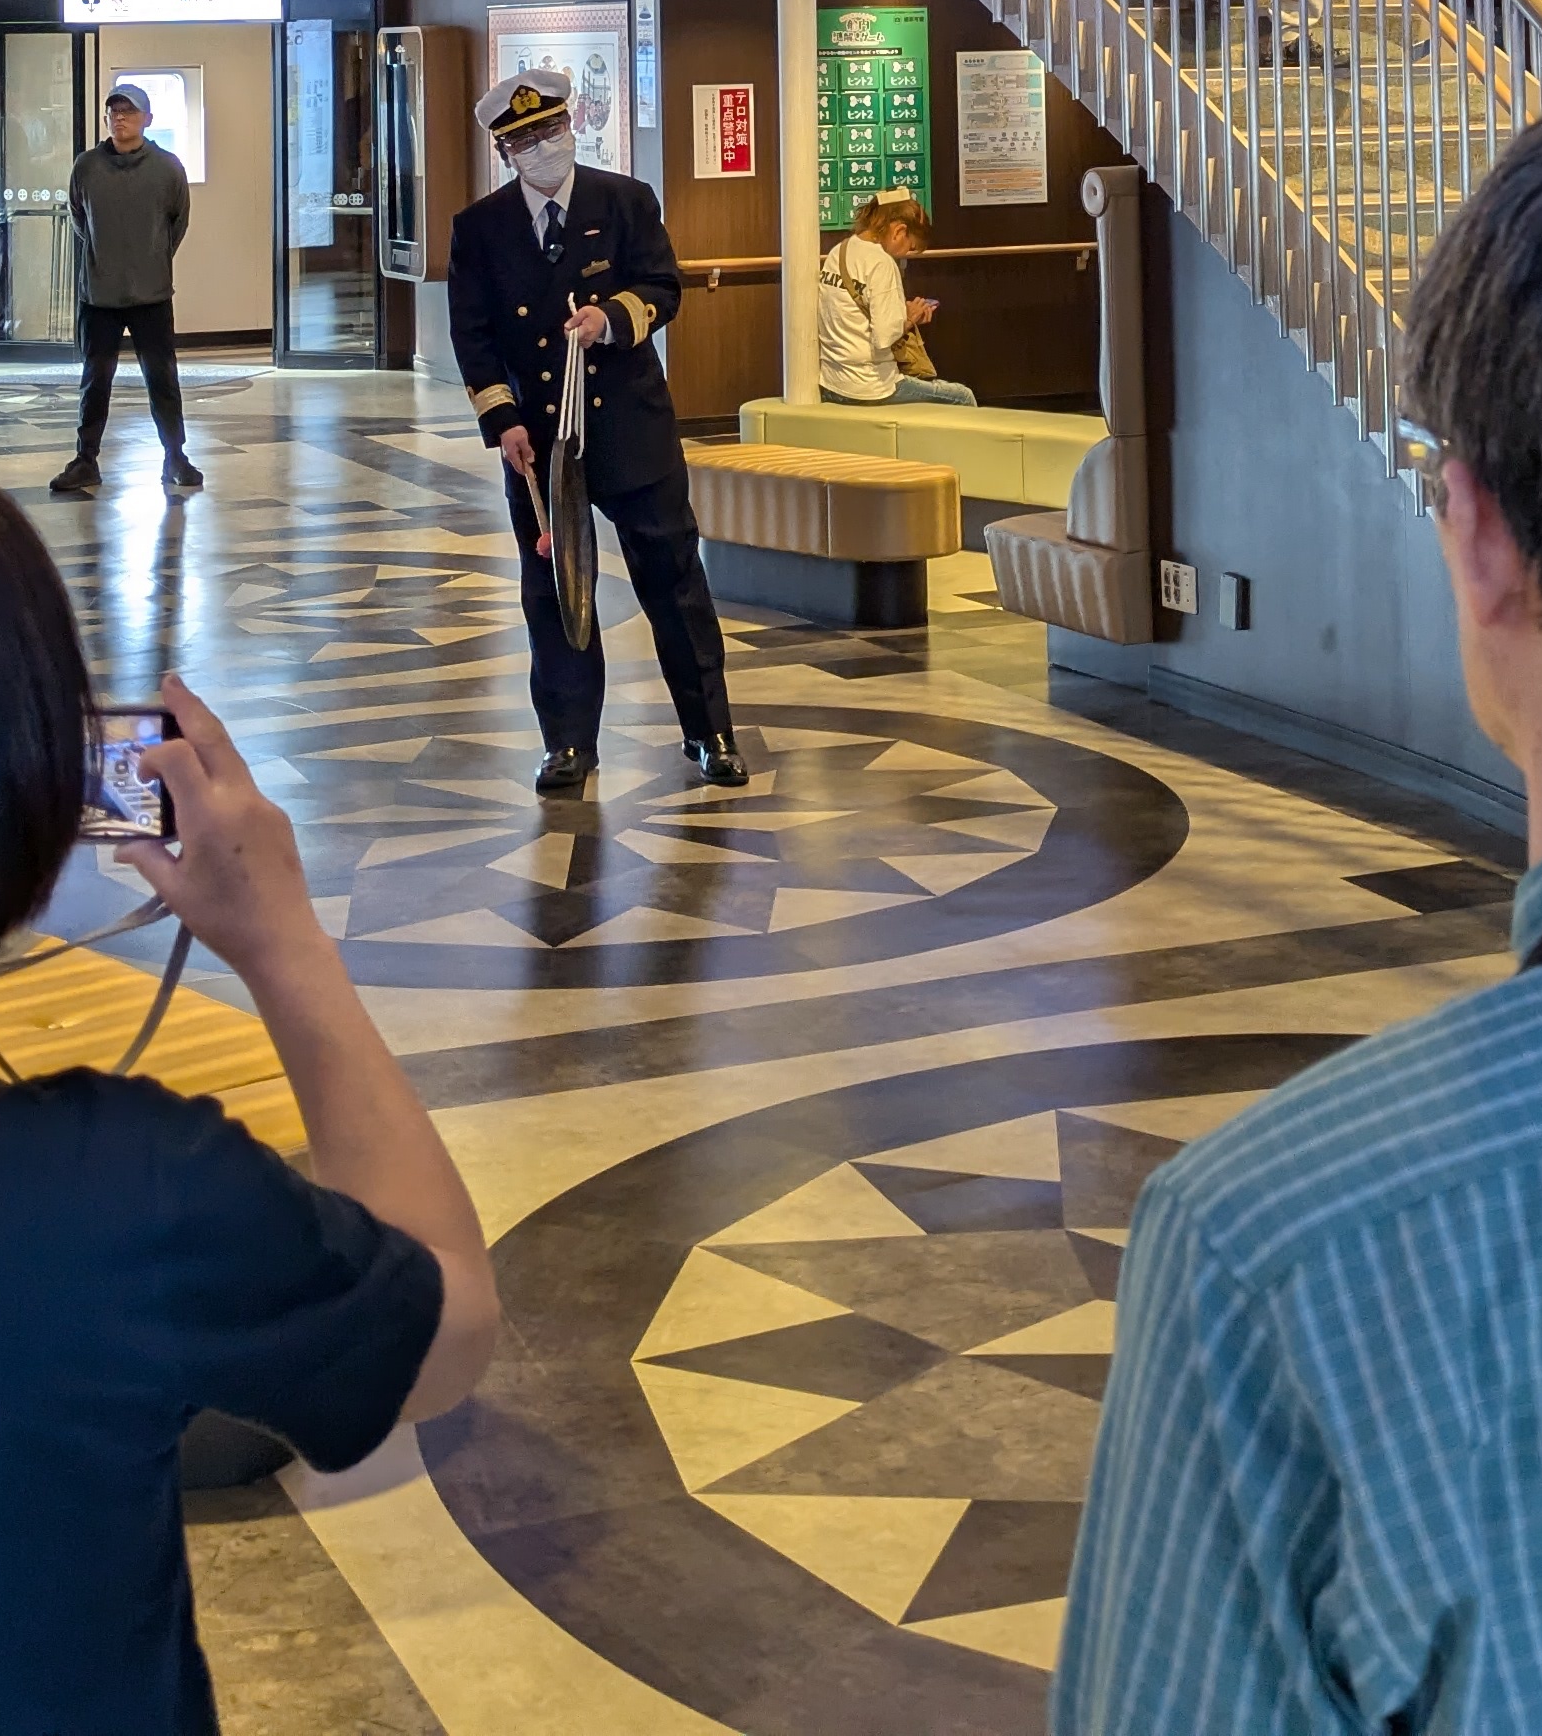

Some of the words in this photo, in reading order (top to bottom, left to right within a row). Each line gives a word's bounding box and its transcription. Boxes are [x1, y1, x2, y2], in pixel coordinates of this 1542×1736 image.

[847, 76, 874, 86] ヒント2
[890, 76, 917, 86] ヒント3
[735, 91, 748, 146] テロ対策
[847, 110, 874, 120] ヒント2
[891, 109, 917, 119] ヒント3
[722, 94, 736, 163] 重点警戒中
[848, 143, 875, 153] ヒント2
[892, 142, 918, 152] ヒント3
[849, 176, 875, 186] ヒント2
[892, 175, 919, 185] ヒント3
